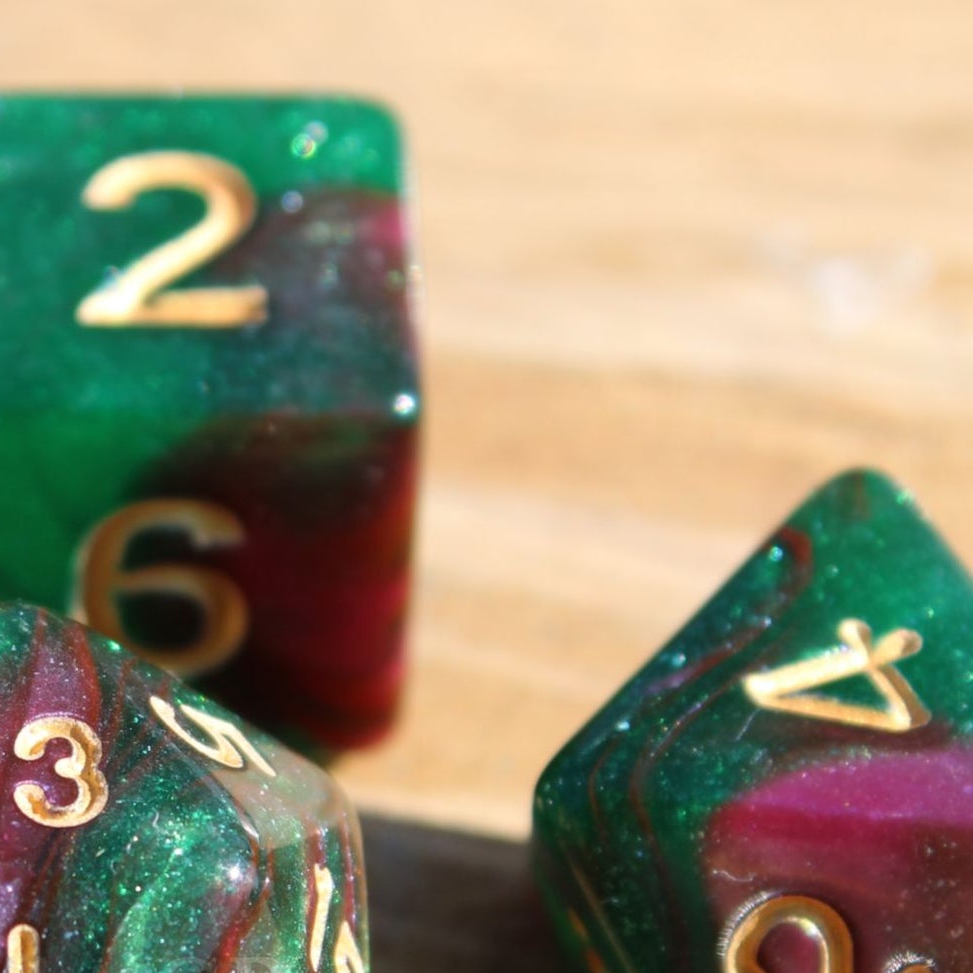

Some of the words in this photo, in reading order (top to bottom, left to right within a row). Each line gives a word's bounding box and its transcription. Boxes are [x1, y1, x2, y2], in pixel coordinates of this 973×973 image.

[75, 149, 269, 328] 2
[71, 500, 251, 678] 6
[149, 694, 277, 778] 5
[741, 617, 932, 733] 4
